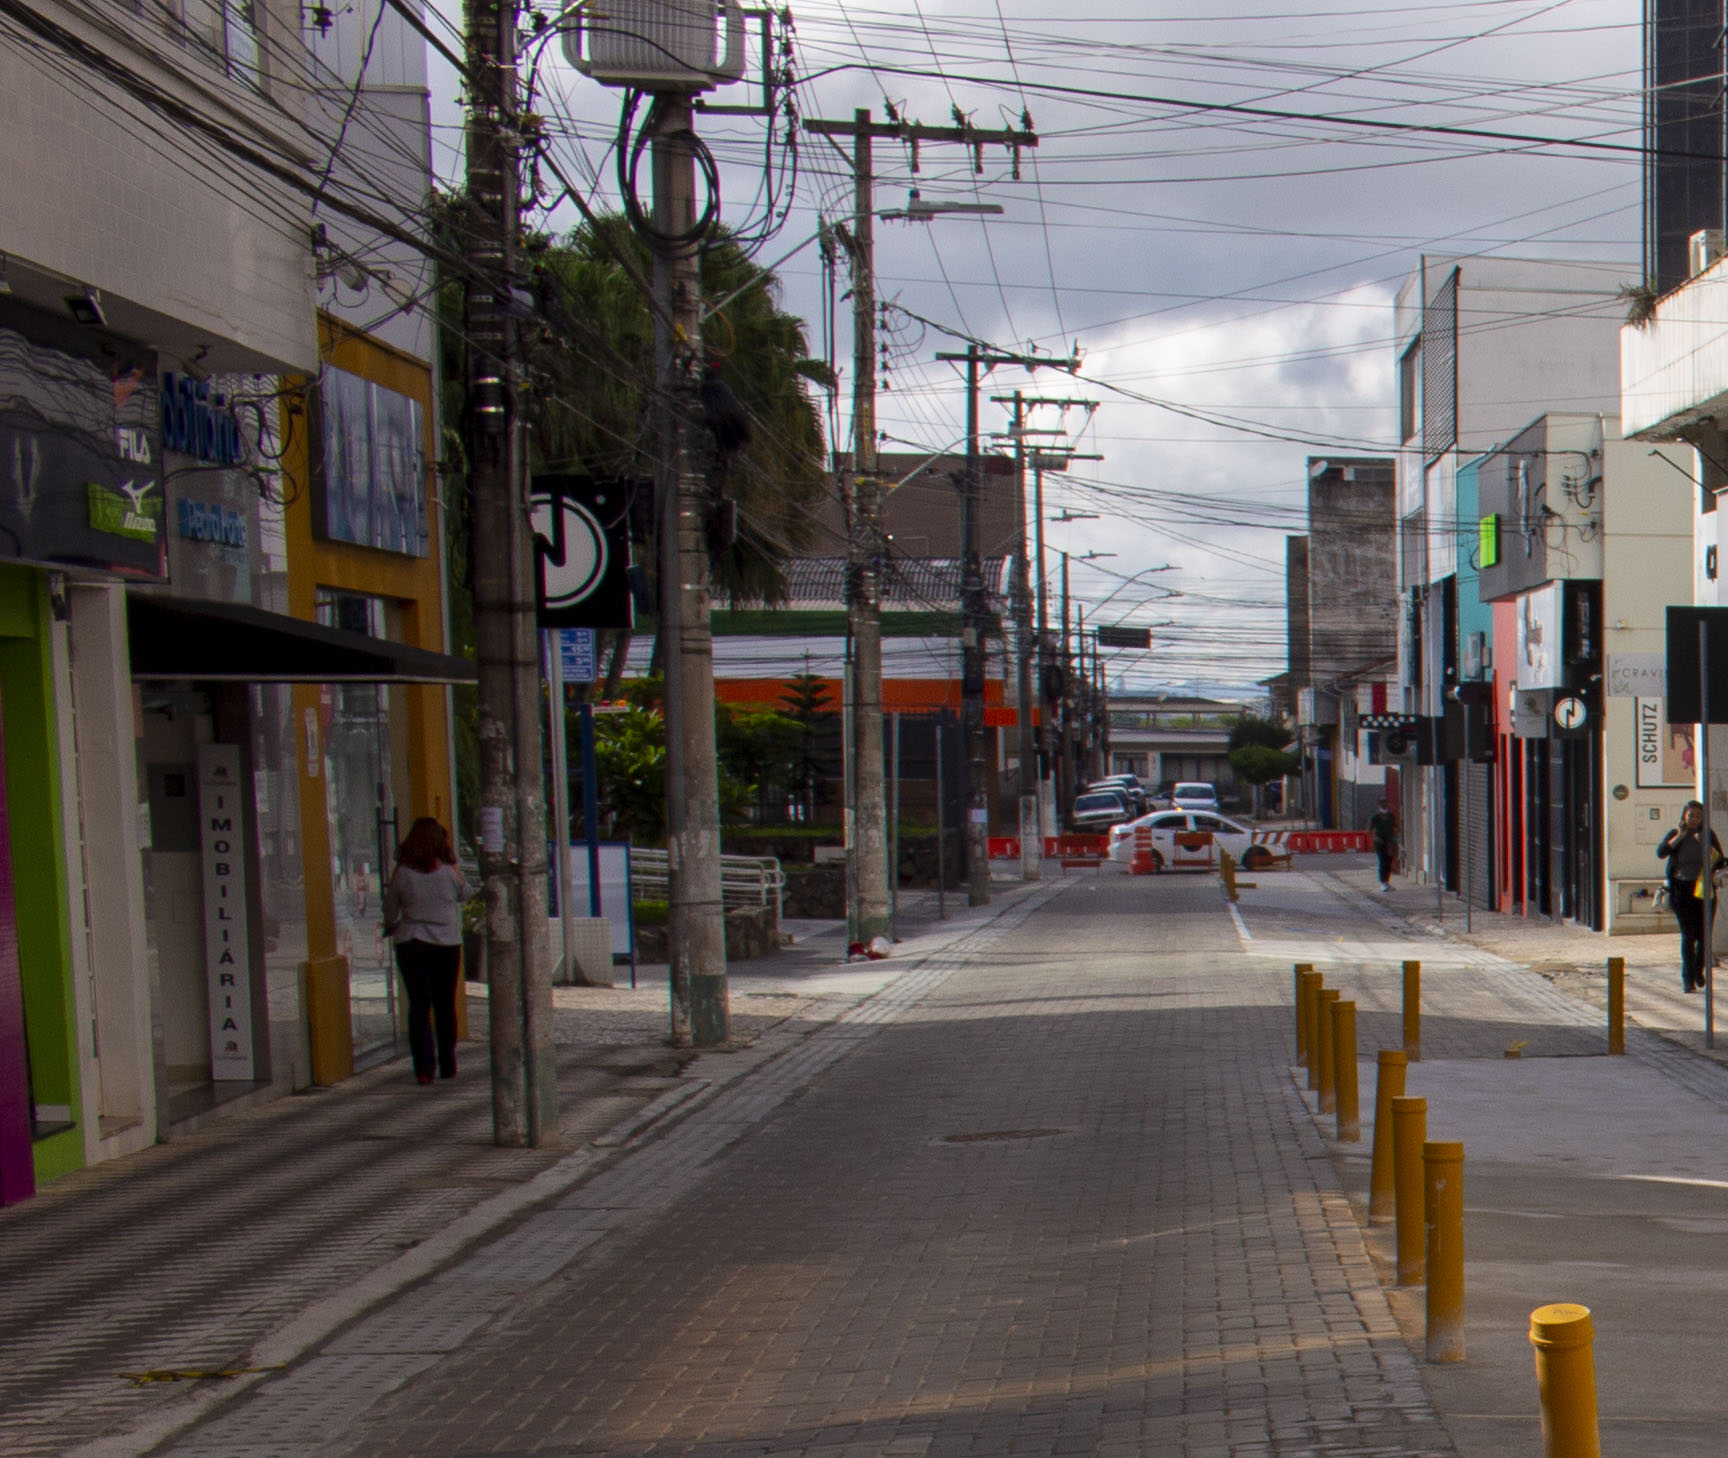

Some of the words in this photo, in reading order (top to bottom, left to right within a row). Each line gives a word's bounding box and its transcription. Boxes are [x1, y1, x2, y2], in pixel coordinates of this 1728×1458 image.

[119, 427, 152, 464] FILA
[1641, 703, 1658, 763] SCHUTZ
[210, 795, 238, 1031] IMOBILIÁRIA
